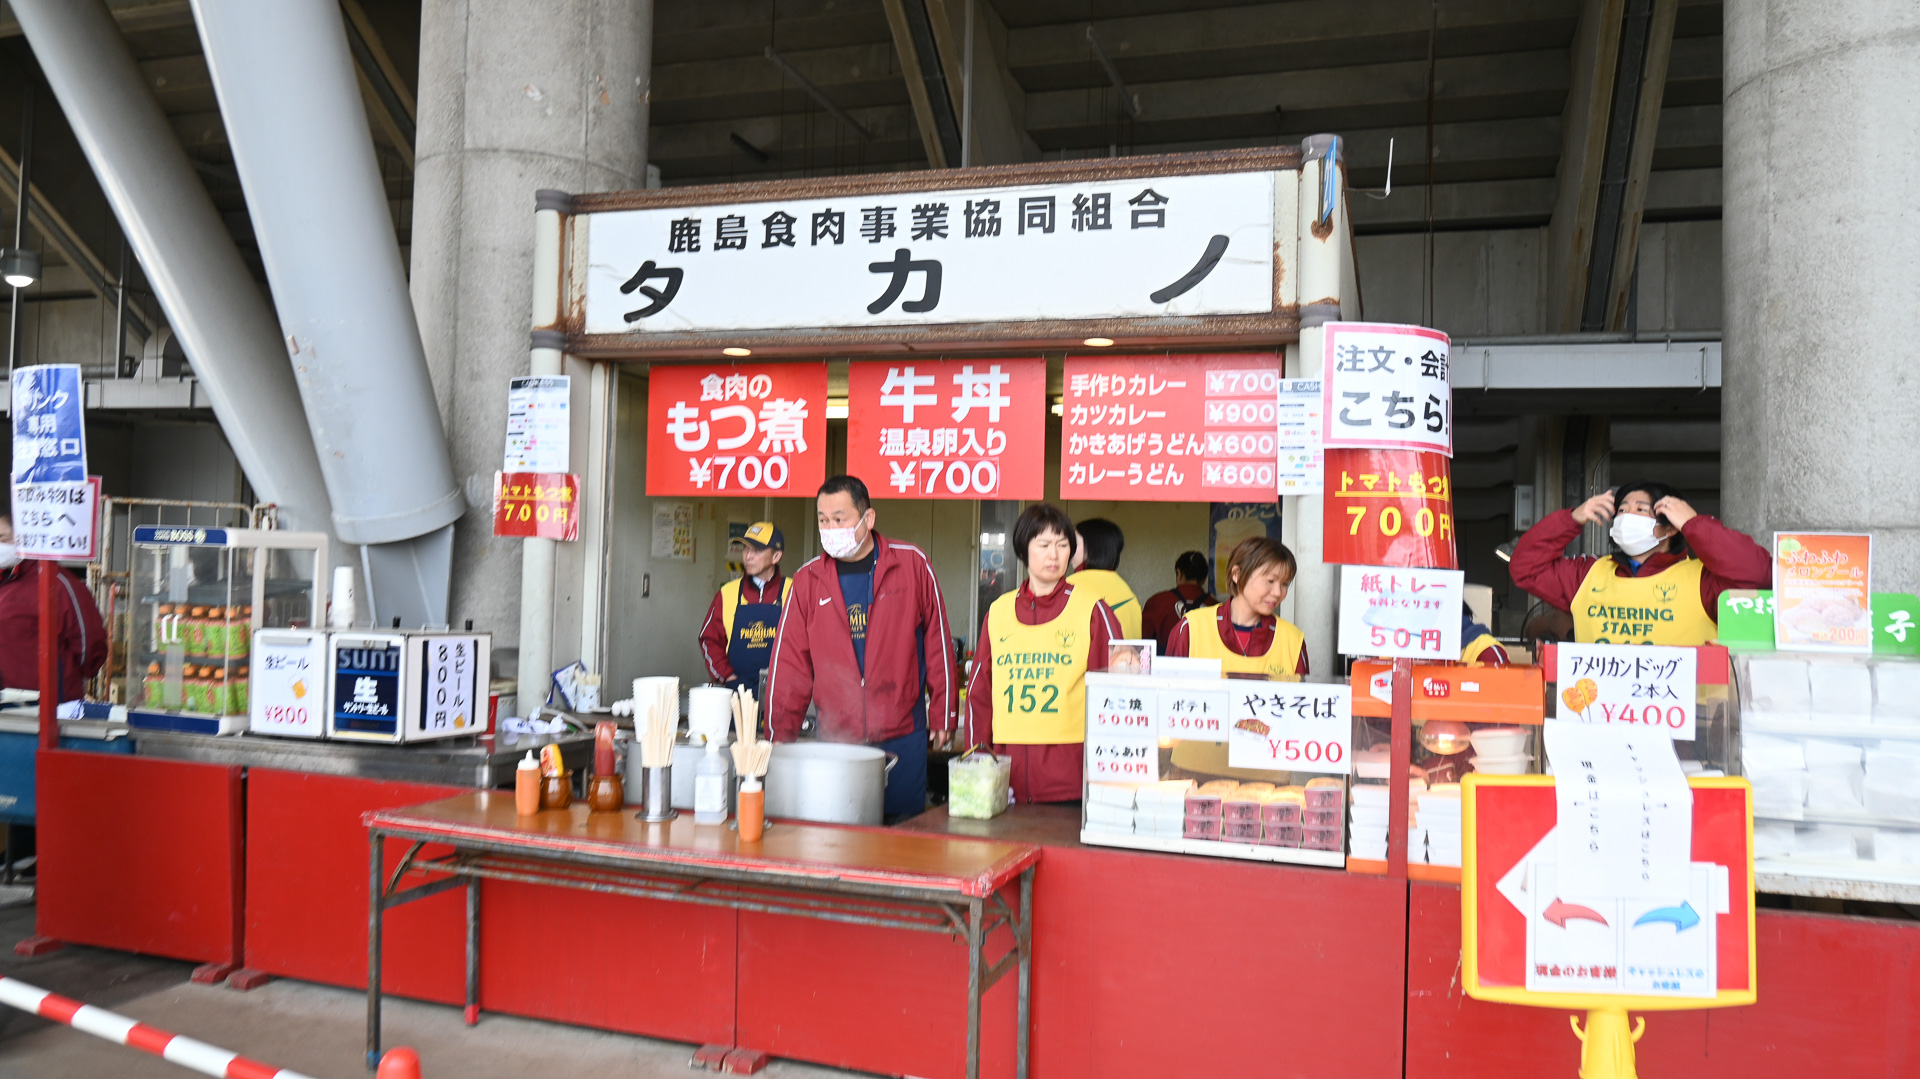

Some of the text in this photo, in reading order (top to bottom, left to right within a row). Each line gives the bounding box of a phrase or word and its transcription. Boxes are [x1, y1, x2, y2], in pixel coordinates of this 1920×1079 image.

[668, 188, 1170, 254] 鹿島食肉事業協同組合
[619, 233, 1231, 324] タカノ
[1336, 344, 1450, 383] 注文・会計
[700, 373, 773, 402] 食肉の
[879, 364, 1011, 424] 牛丼
[1069, 371, 1276, 398] 手作りカレー ¥700
[666, 397, 809, 455] もつ煮
[1068, 402, 1275, 426] カツカレー ¥900
[879, 428, 1007, 458] 温泉卵入り
[1068, 432, 1274, 457] かきあげうどん ¥600
[688, 455, 788, 490] ¥700
[888, 460, 997, 494] ¥700
[1068, 462, 1273, 486] カレーうどん ¥600
[502, 484, 573, 502] トマトもつ煮
[503, 503, 569, 524] 700円
[1346, 505, 1451, 541] 700円
[1786, 549, 1849, 565] ふわふわ
[1360, 573, 1447, 594] 紙トレー
[1587, 605, 1674, 622] CATERING
[1371, 625, 1442, 652] 50円
[1601, 621, 1654, 637] STAFF
[264, 653, 310, 671] 生ビール
[996, 652, 1073, 666] CATERING
[1571, 656, 1683, 680] アメリカンドッグ
[453, 641, 467, 708] 生ビール
[1008, 667, 1055, 680] STAFF
[353, 676, 378, 703] 生
[435, 643, 448, 729] 800円
[1631, 683, 1679, 700] 2本入
[1003, 684, 1059, 713] 152
[1103, 698, 1143, 712] たこ焼
[1172, 699, 1210, 713] ポテト
[1242, 693, 1341, 719] やきそば
[264, 704, 309, 725] ¥800
[1098, 714, 1149, 728] 500円
[1167, 716, 1220, 731] 300円
[1601, 703, 1686, 729] ¥400
[1095, 745, 1149, 759] からあげ
[1268, 739, 1343, 763] ¥500
[1097, 761, 1149, 775] 500円
